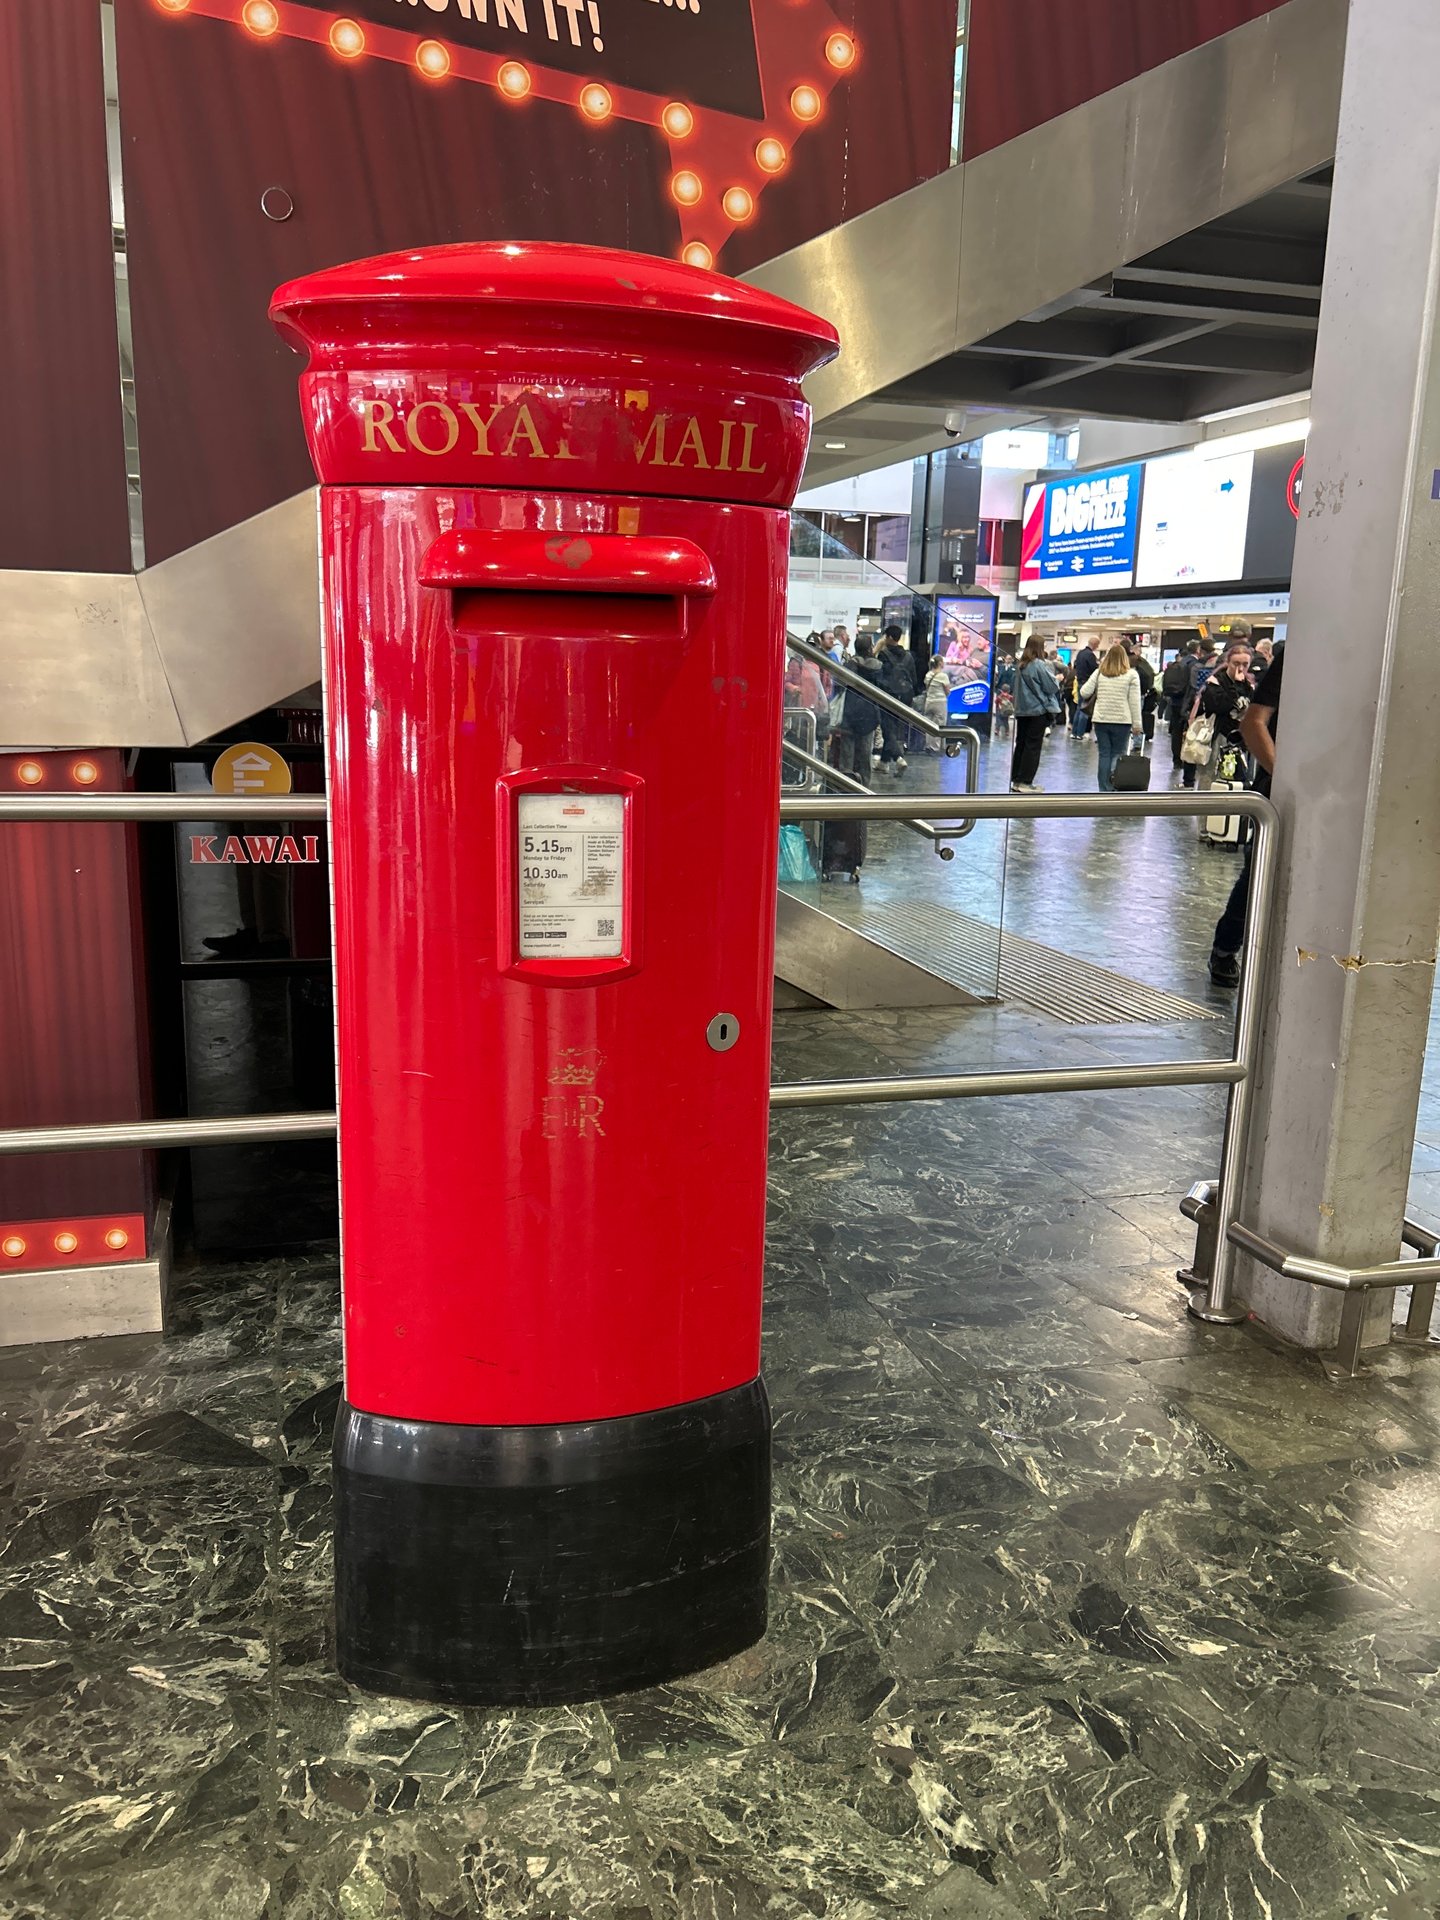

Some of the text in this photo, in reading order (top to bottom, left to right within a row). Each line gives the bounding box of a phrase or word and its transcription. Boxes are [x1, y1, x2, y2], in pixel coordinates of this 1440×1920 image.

[542, 0, 604, 53] IT!
[189, 835, 320, 864] KAWAI
[524, 836, 573, 854] 5.15pm
[523, 867, 568, 879] 10.30am
